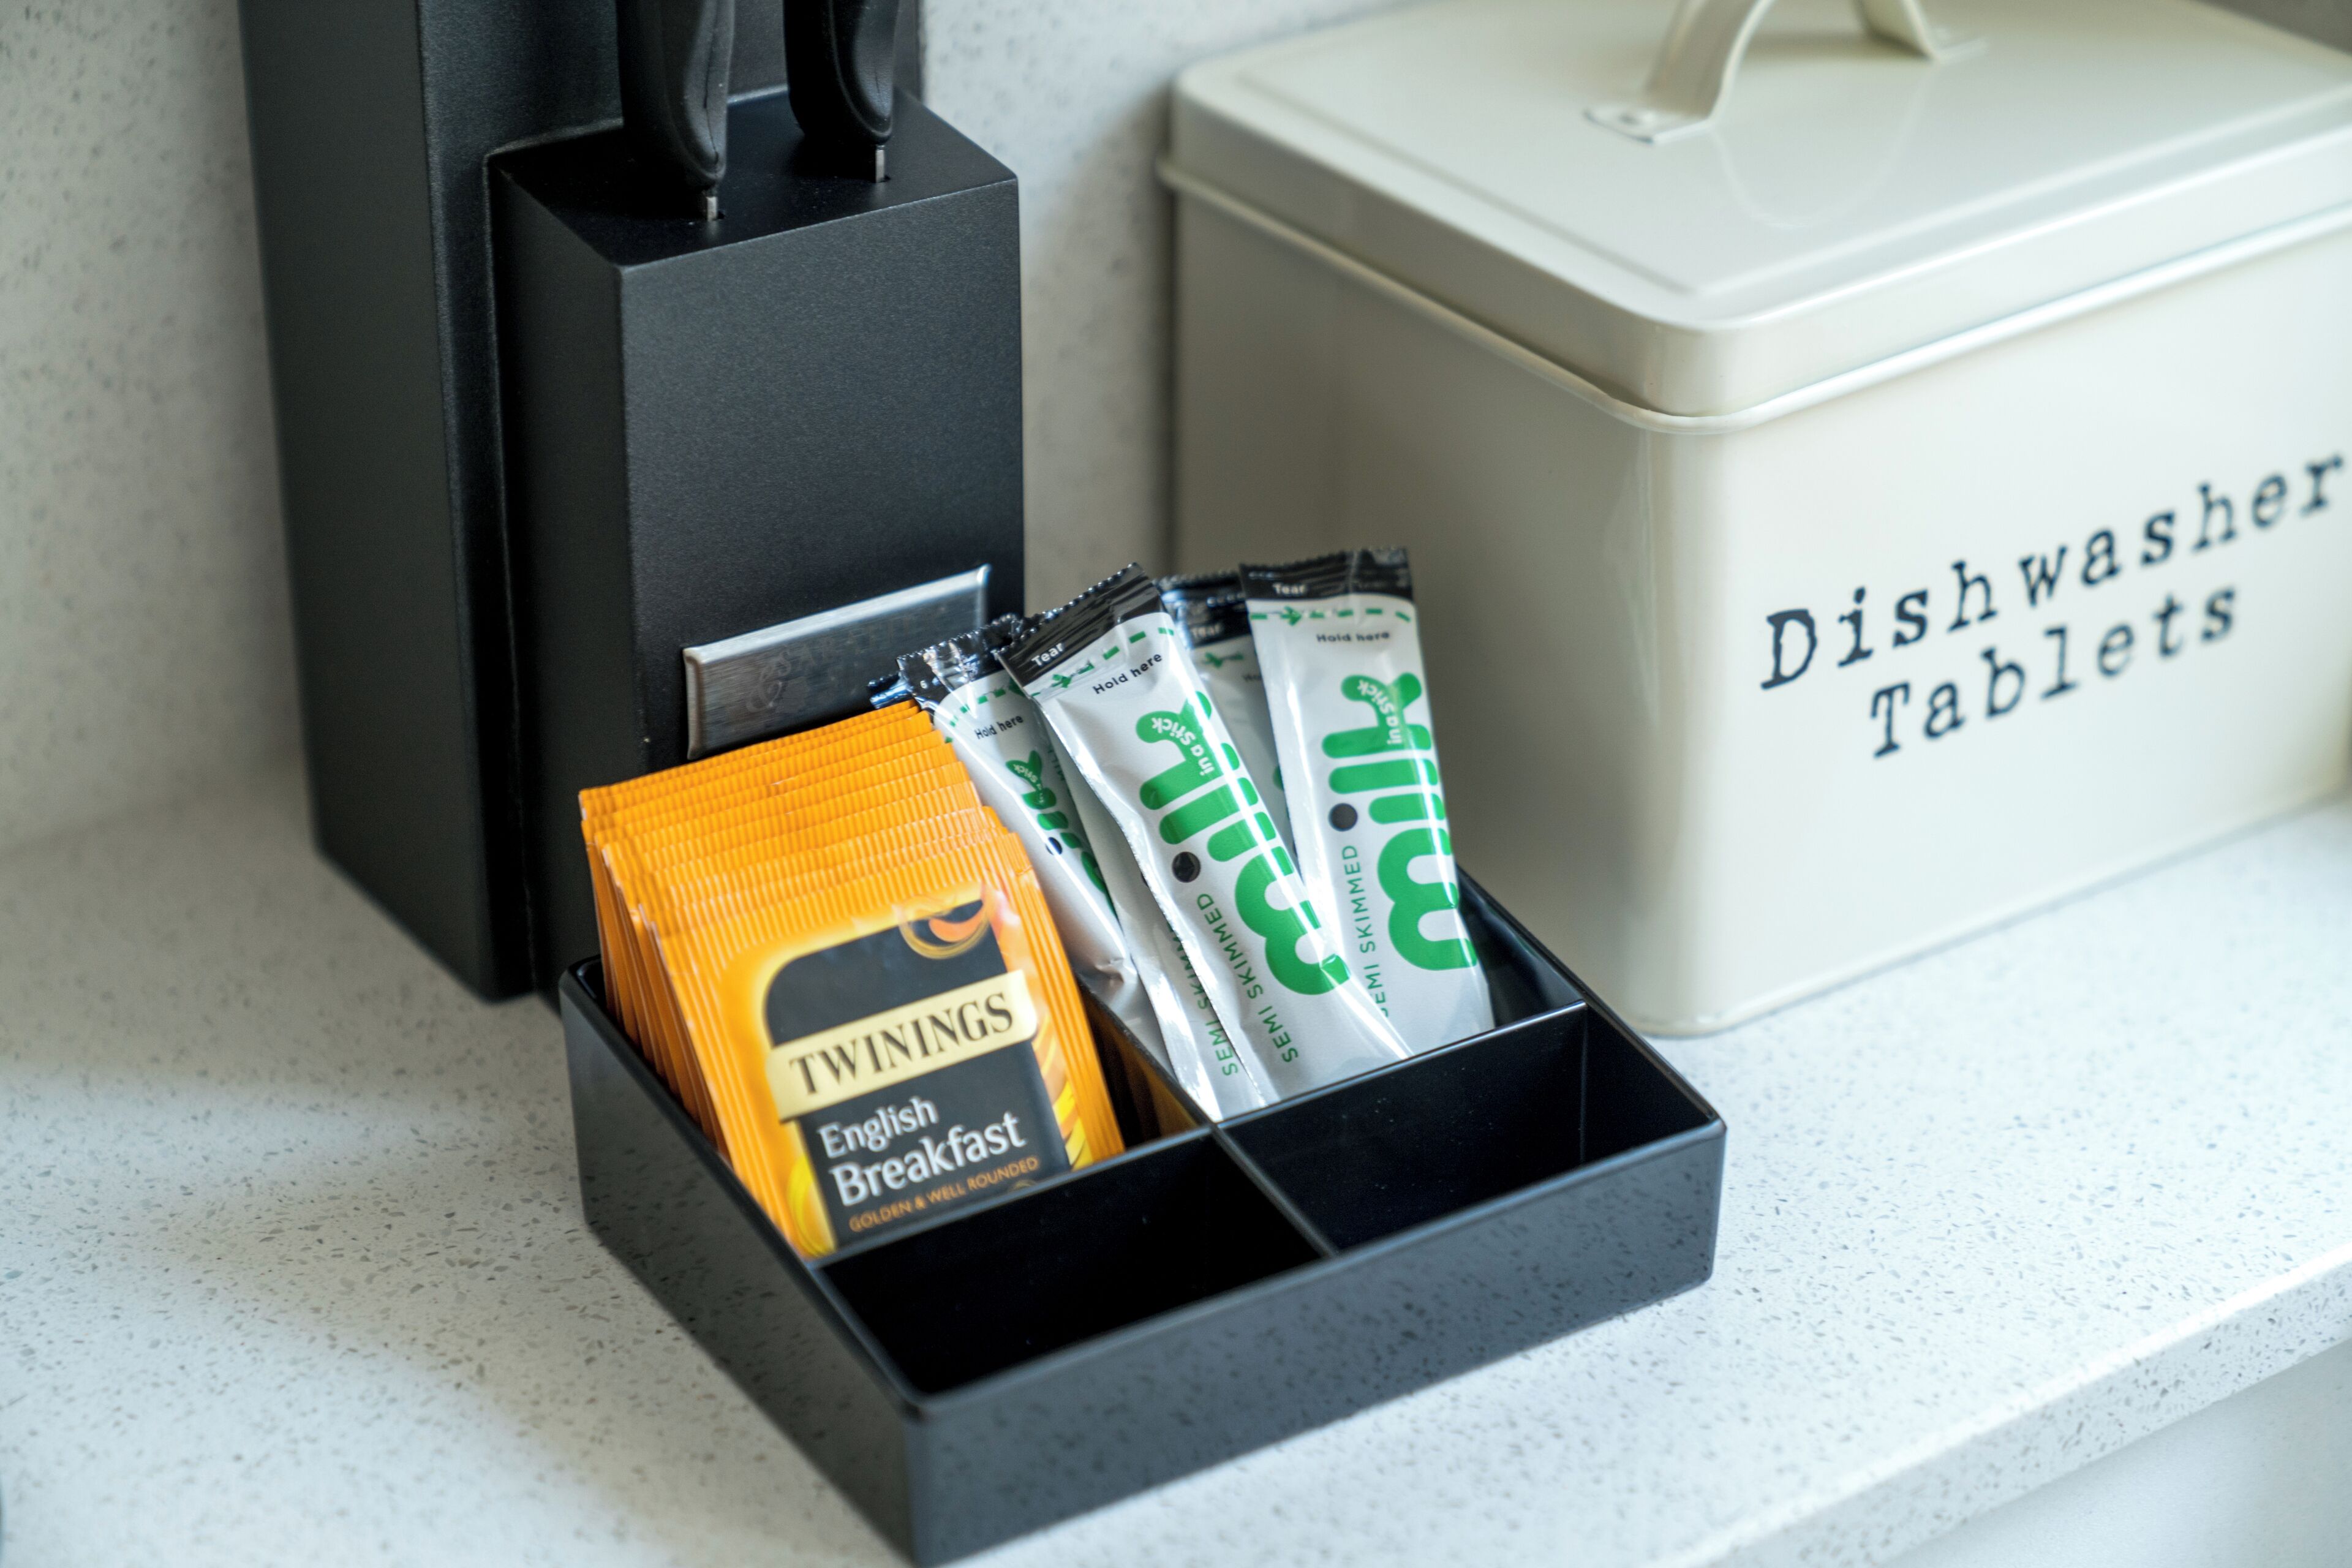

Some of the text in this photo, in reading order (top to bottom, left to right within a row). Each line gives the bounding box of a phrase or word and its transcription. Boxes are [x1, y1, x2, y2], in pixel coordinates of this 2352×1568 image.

[1272, 582, 1306, 595] Tear
[1760, 452, 2345, 690] Dishwasher
[1031, 643, 1063, 667] Tear
[1316, 630, 1390, 642] Hold here
[1092, 652, 1163, 695] Hold here
[1869, 584, 2237, 760] Tablets
[974, 715, 1023, 739] Hold here
[1357, 679, 1402, 745] in a Stick
[1151, 717, 1215, 776] in a Stick
[1342, 845, 1377, 954] SKIMMED
[1196, 893, 1299, 1063] SEMI SKIMMED
[788, 991, 1015, 1095] TWININGS
[1205, 1017, 1239, 1076] SEMI
[817, 1096, 938, 1159] English
[829, 1110, 1027, 1207] Breakfast
[848, 1155, 1039, 1232] GOLDEN & WELL ROUNDED
